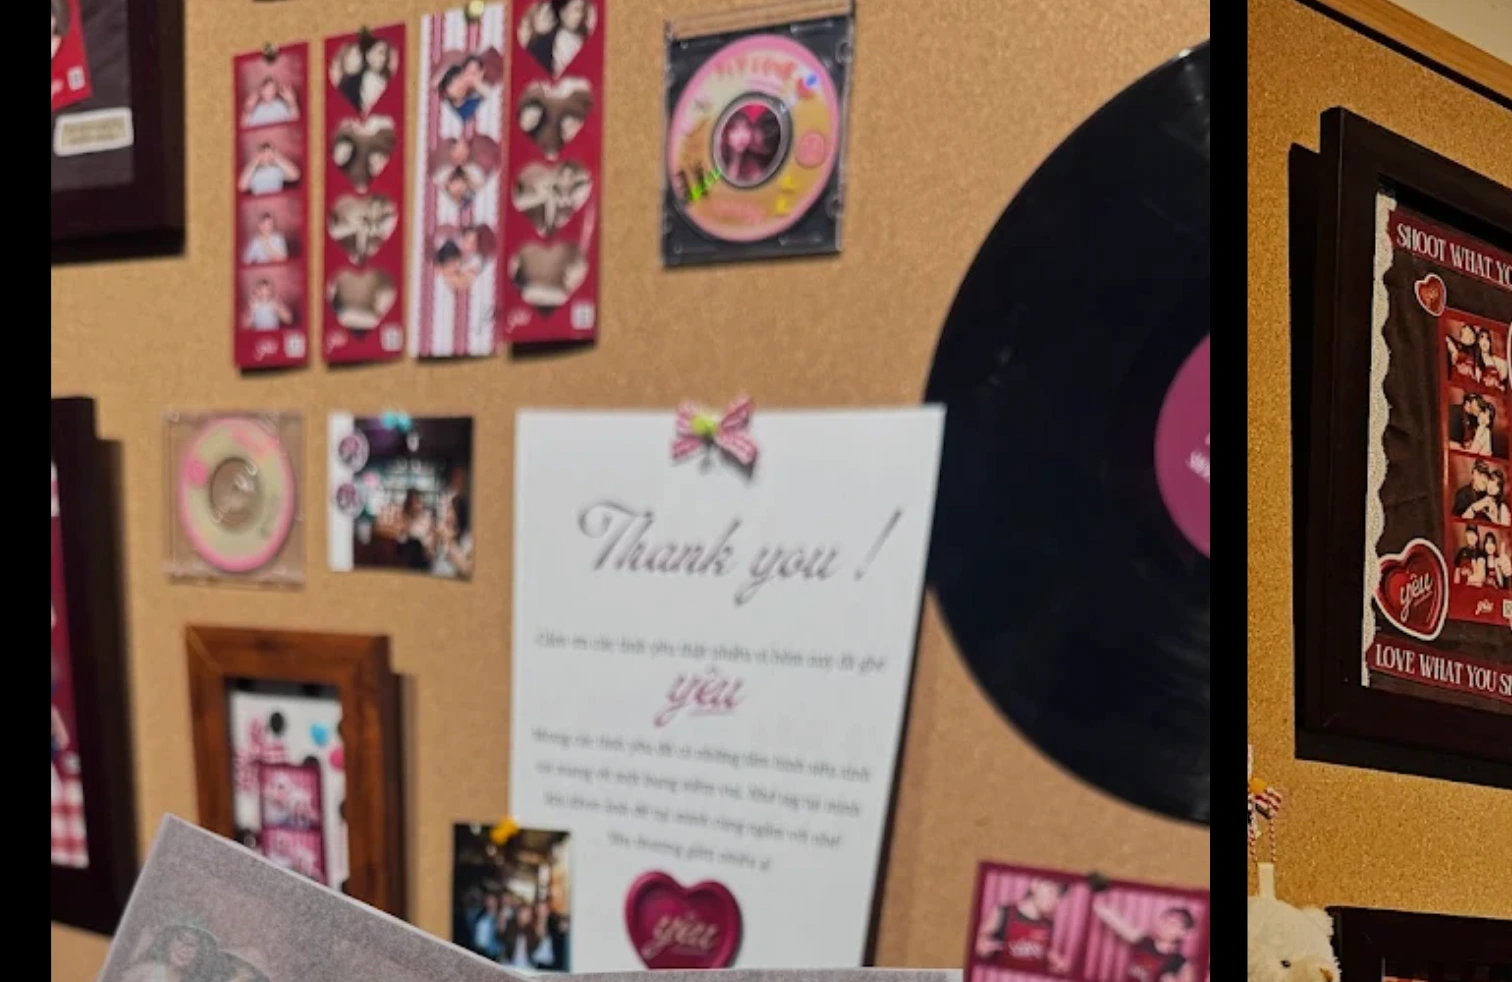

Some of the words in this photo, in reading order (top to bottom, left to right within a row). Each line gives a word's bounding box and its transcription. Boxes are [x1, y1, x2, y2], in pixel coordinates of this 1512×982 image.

[1396, 223, 1447, 261] SHOOT
[1449, 243, 1493, 280] WHAT
[577, 500, 742, 576] Thank
[734, 543, 840, 607] you
[1400, 569, 1435, 622] yêu
[1376, 643, 1415, 674] LOVE
[1419, 653, 1464, 684] WHAT
[1466, 664, 1498, 692] YOU
[653, 665, 743, 728] yêu
[641, 909, 720, 960] yêu
